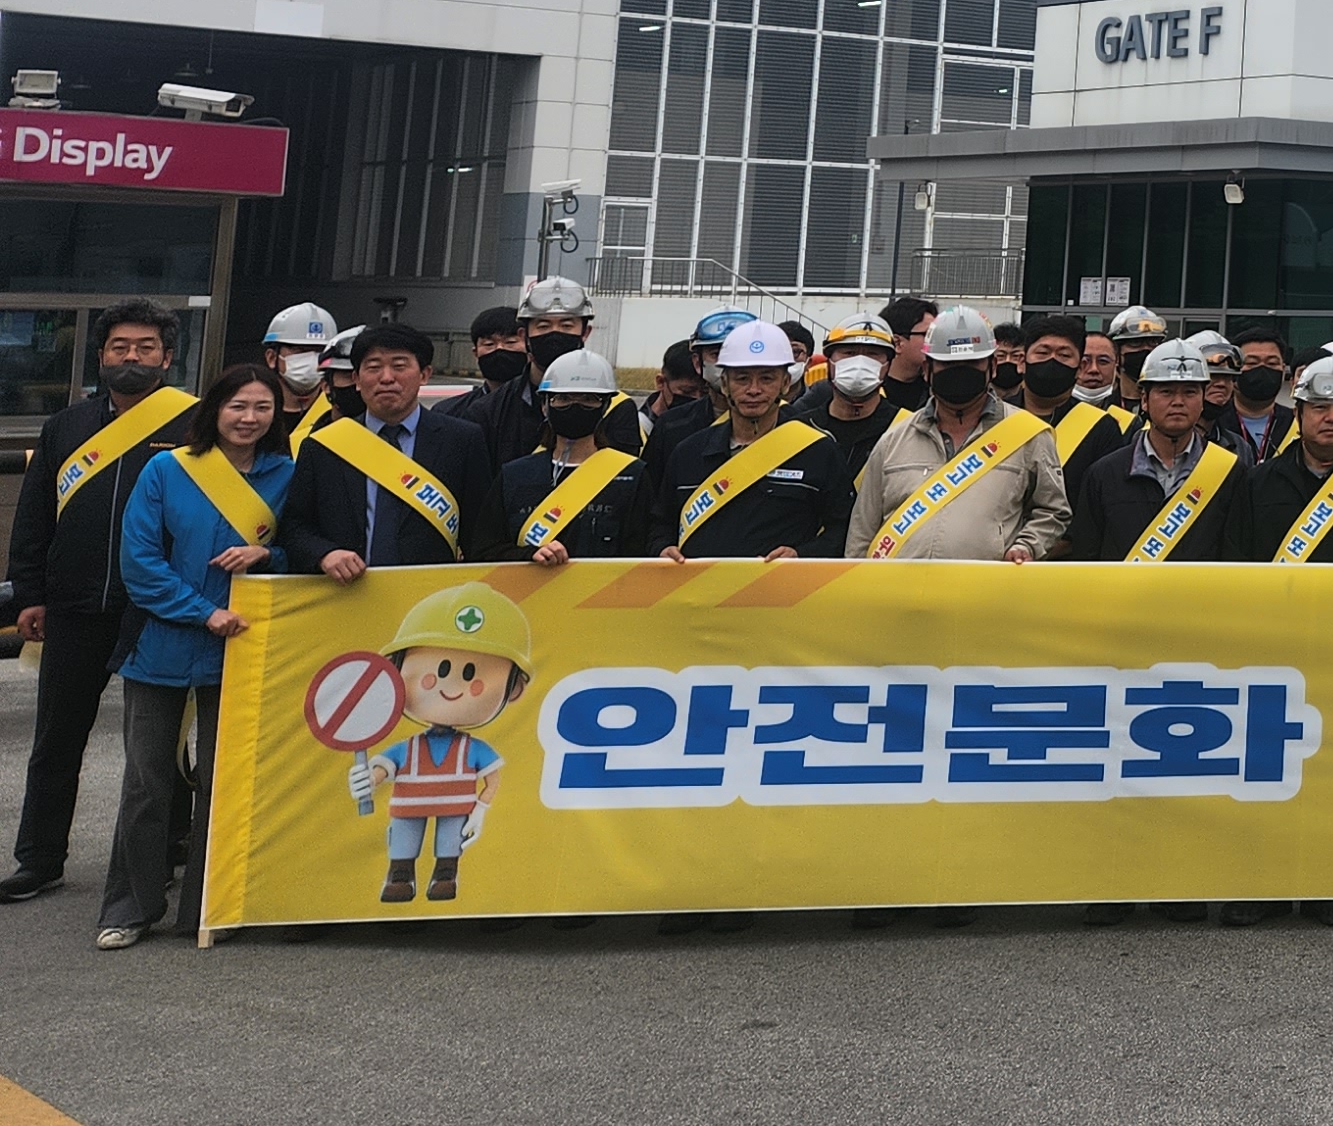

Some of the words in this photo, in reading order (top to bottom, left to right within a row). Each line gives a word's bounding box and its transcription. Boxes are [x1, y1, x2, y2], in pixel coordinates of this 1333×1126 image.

[1094, 9, 1190, 64] GATE
[1199, 6, 1223, 55] F
[13, 127, 173, 180] Display
[945, 454, 984, 486] 보고
[893, 499, 928, 535] 보고
[1158, 503, 1192, 539] 보고
[557, 680, 1303, 789] 안전문화
